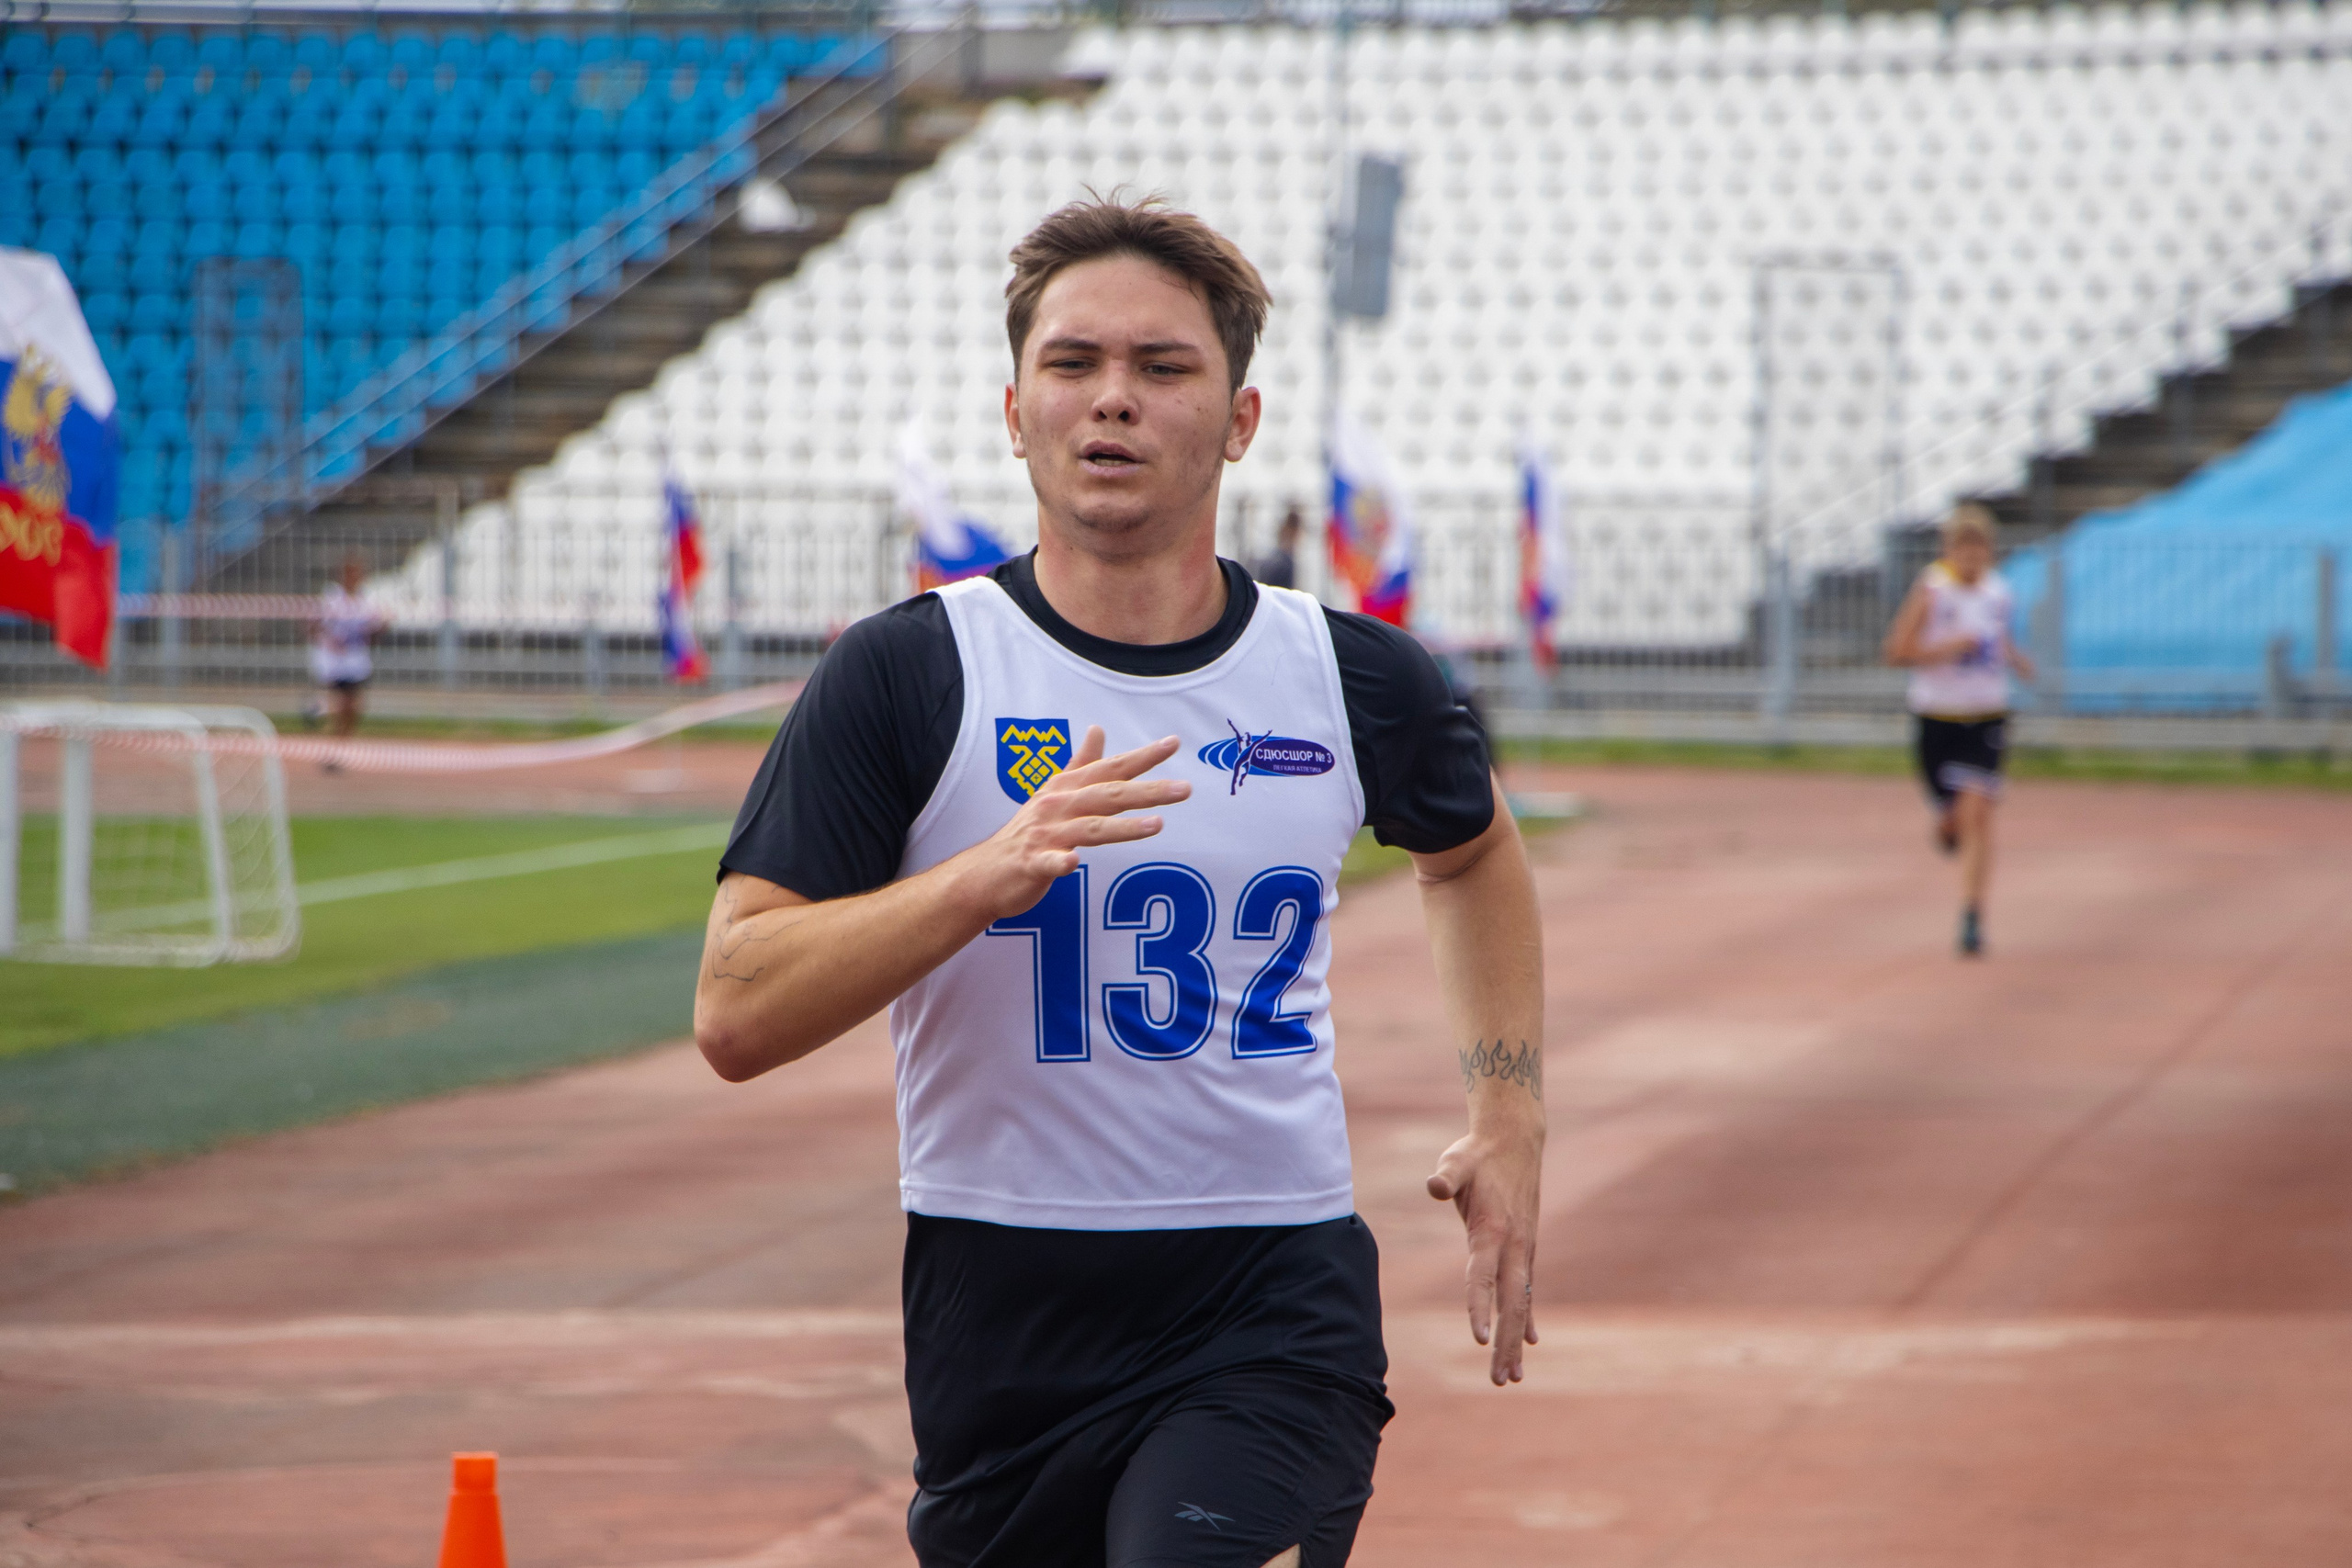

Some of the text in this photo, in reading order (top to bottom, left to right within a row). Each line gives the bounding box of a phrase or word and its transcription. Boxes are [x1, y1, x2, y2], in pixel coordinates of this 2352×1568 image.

[1255, 748, 1333, 763] СДЮСШОР № 3
[985, 861, 1325, 1064] 132
